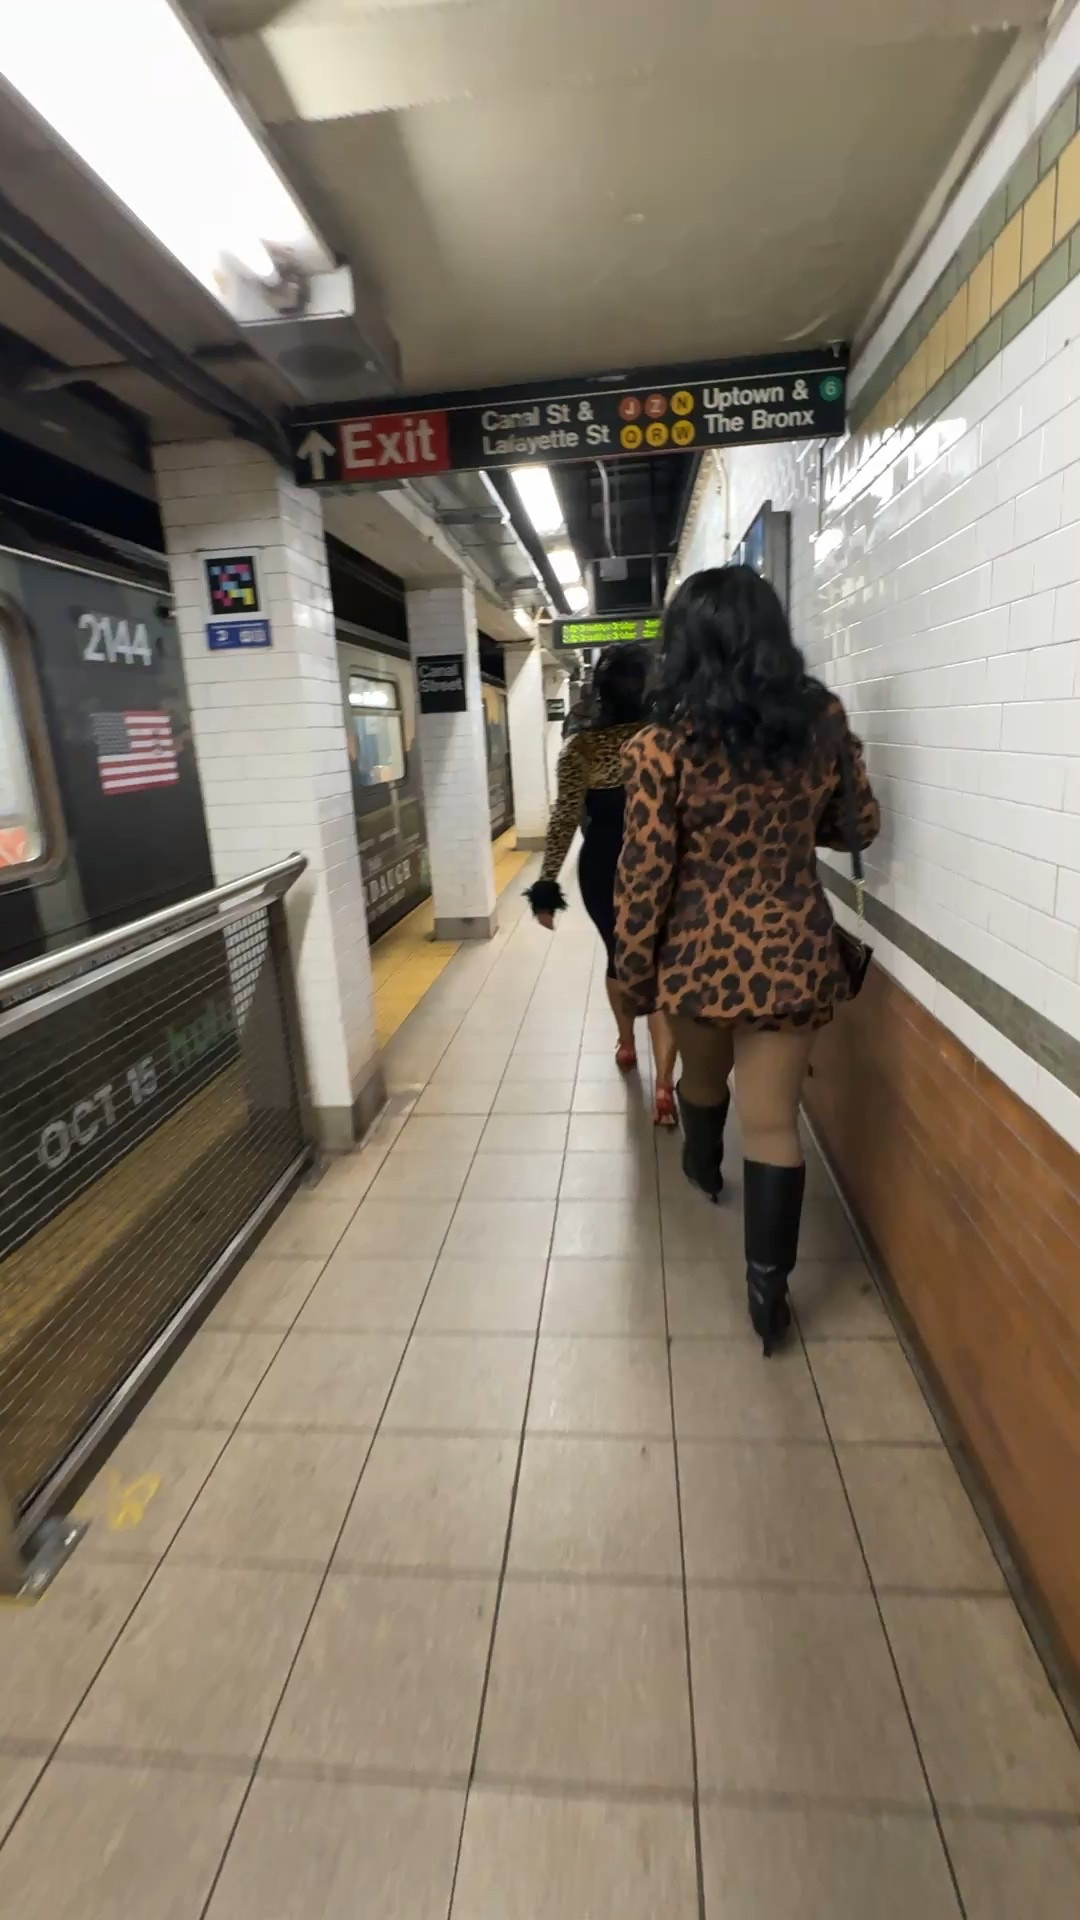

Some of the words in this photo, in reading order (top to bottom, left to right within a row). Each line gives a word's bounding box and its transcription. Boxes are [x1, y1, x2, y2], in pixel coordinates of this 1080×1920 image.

[702, 386, 785, 412] Uptown
[791, 379, 810, 401] &
[481, 406, 541, 432] Canal
[546, 403, 571, 425] St
[577, 400, 595, 421] &
[703, 413, 745, 434] The
[751, 409, 815, 430] Bronx
[341, 418, 437, 469] Exit
[482, 428, 579, 456] Lafayette
[586, 424, 612, 445] St
[78, 613, 152, 666] 2144
[37, 1084, 117, 1169] OCT
[126, 1056, 159, 1106] 15
